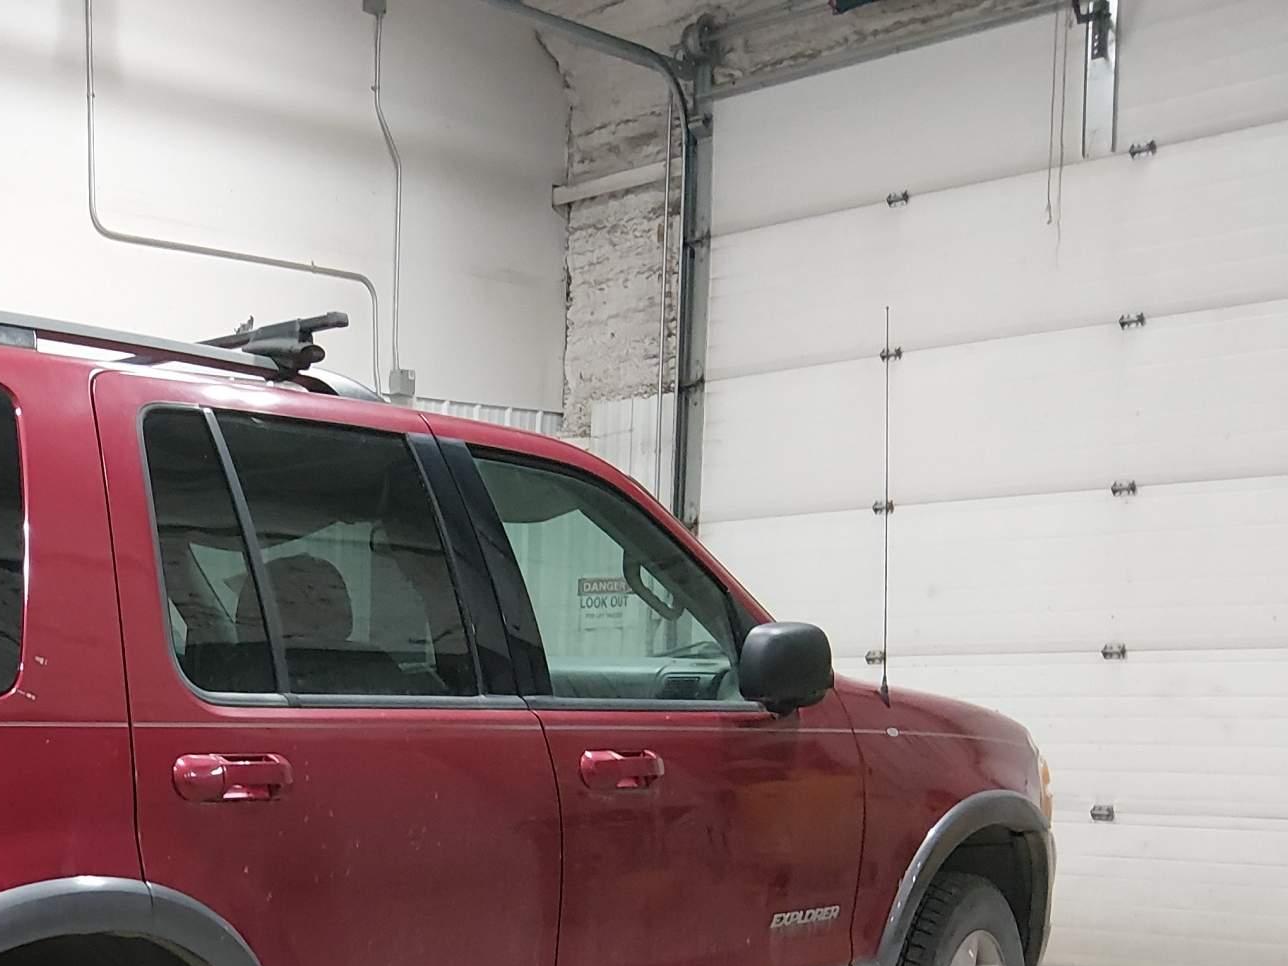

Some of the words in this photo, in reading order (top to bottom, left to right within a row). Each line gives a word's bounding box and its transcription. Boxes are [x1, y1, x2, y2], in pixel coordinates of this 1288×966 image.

[583, 581, 627, 593] DANGER
[580, 596, 608, 609] LOOK
[610, 595, 629, 608] OUT
[770, 905, 840, 928] EXPLORER
